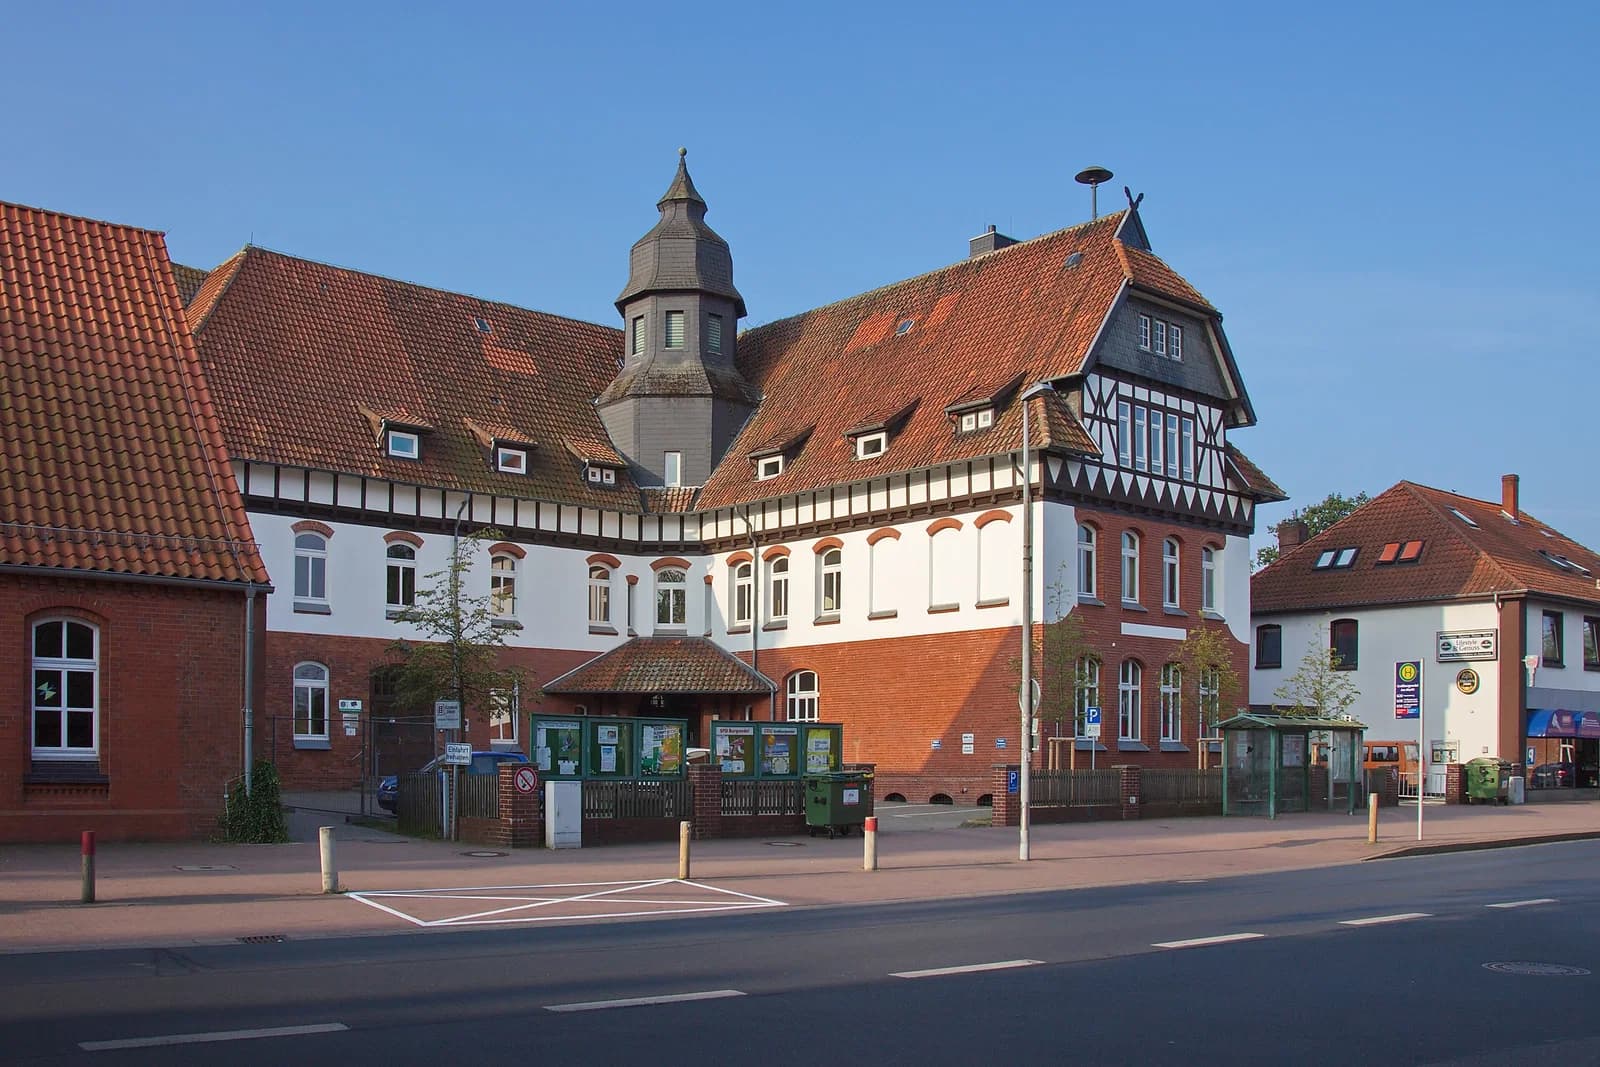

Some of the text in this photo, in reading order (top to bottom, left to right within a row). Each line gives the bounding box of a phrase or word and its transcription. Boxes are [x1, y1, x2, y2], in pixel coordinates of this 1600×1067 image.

[1459, 644, 1480, 652] Genuss
[1404, 667, 1412, 678] H
[1090, 709, 1098, 722] P
[1010, 772, 1017, 784] P
